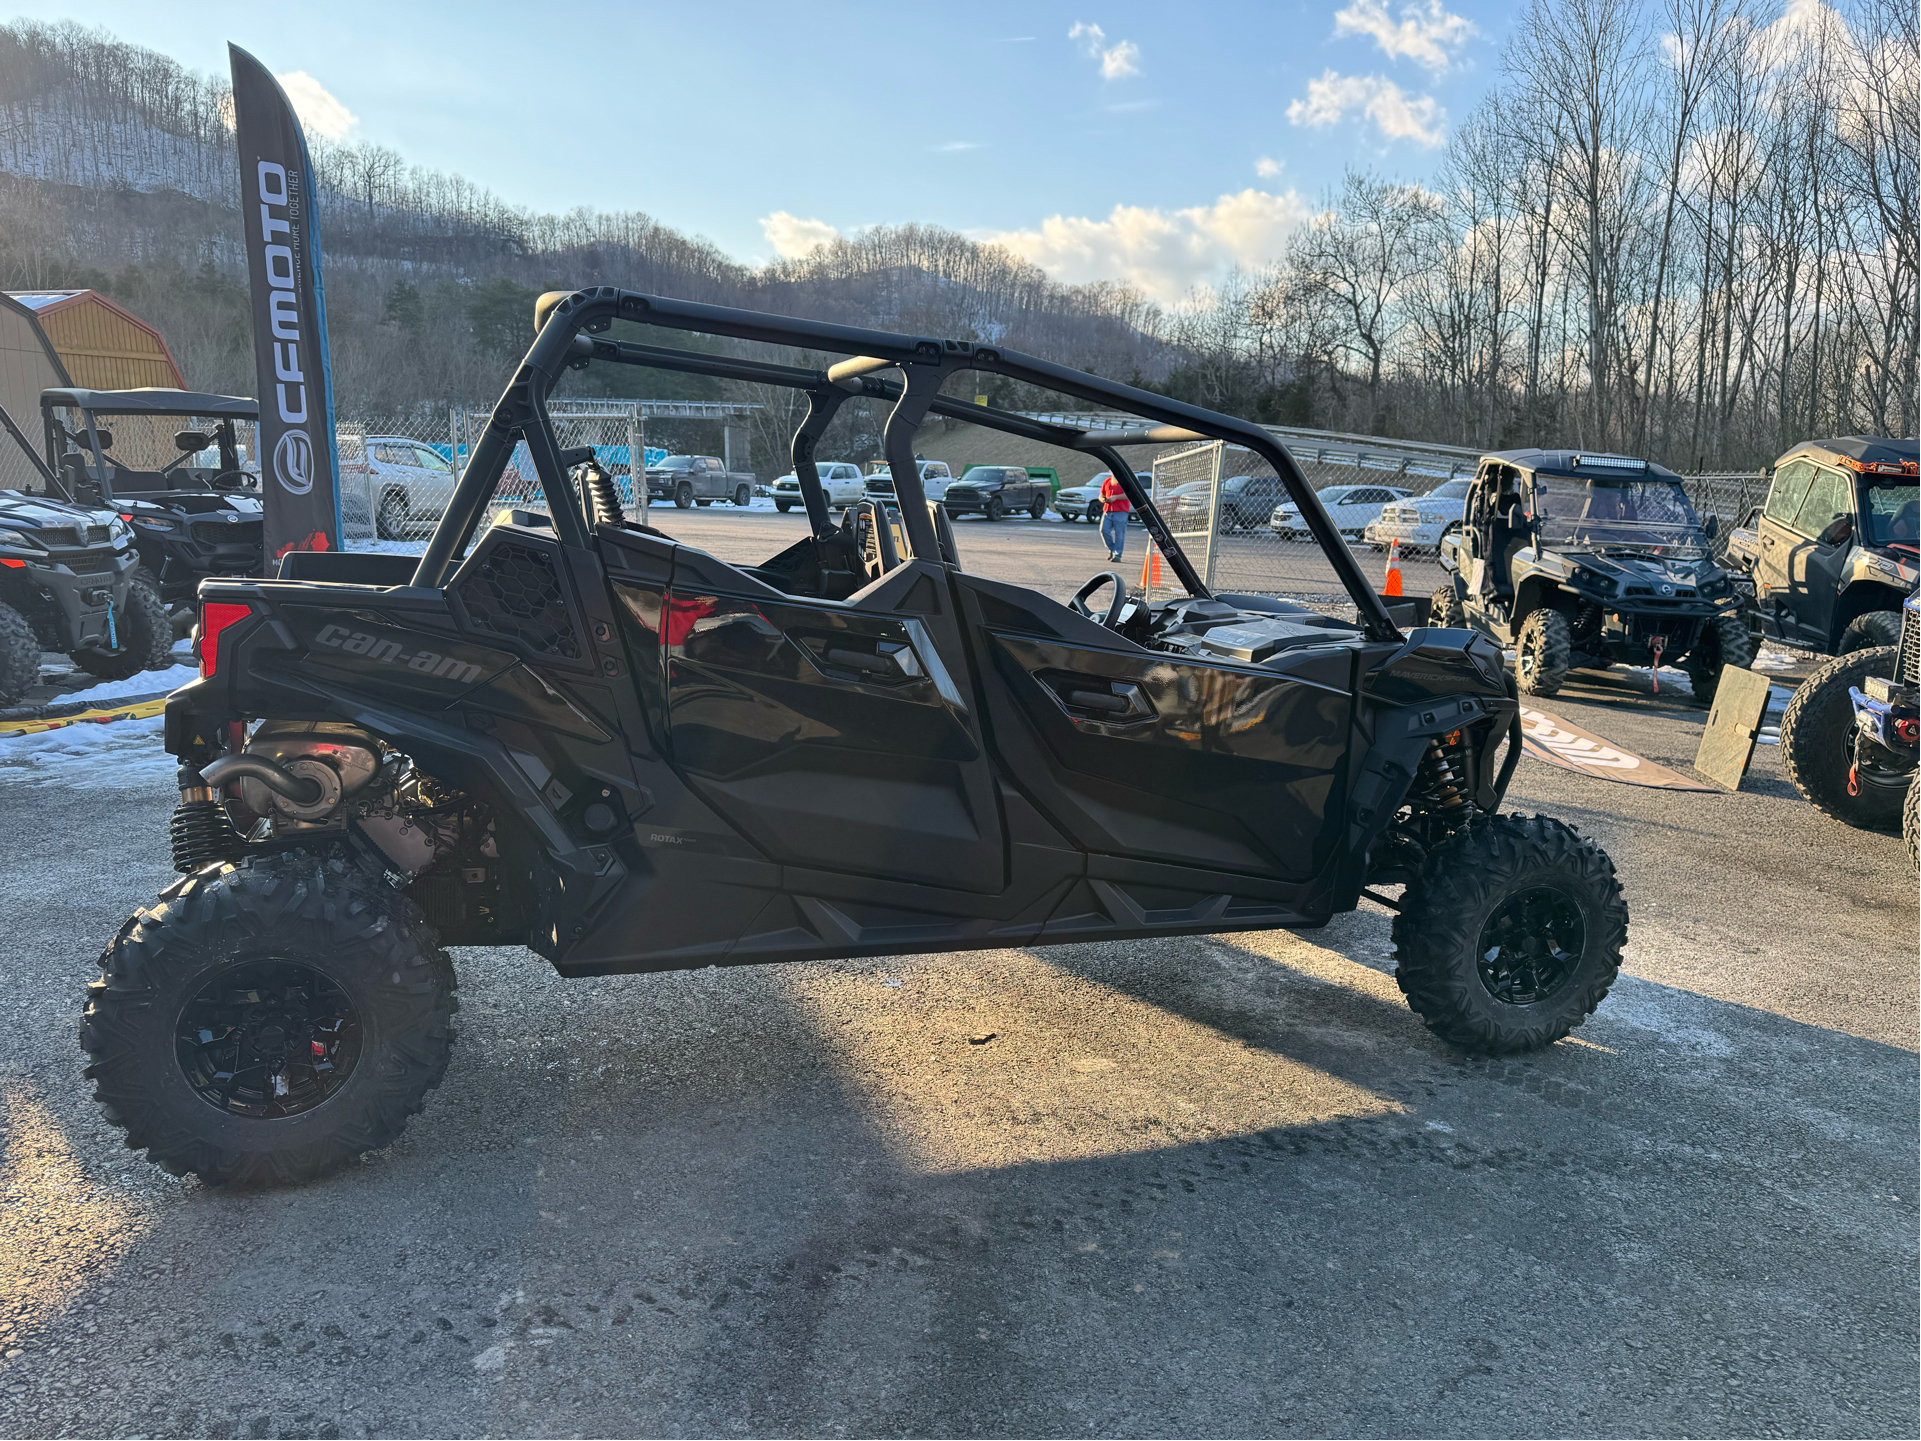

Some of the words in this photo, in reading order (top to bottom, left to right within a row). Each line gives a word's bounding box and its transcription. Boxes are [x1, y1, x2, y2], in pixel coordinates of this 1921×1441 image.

[287, 169, 299, 220] TOGETHER
[257, 160, 307, 424] CFMOTO
[315, 624, 482, 684] can-am
[1389, 670, 1445, 682] MAVERICK
[650, 833, 683, 845] ROTAX
